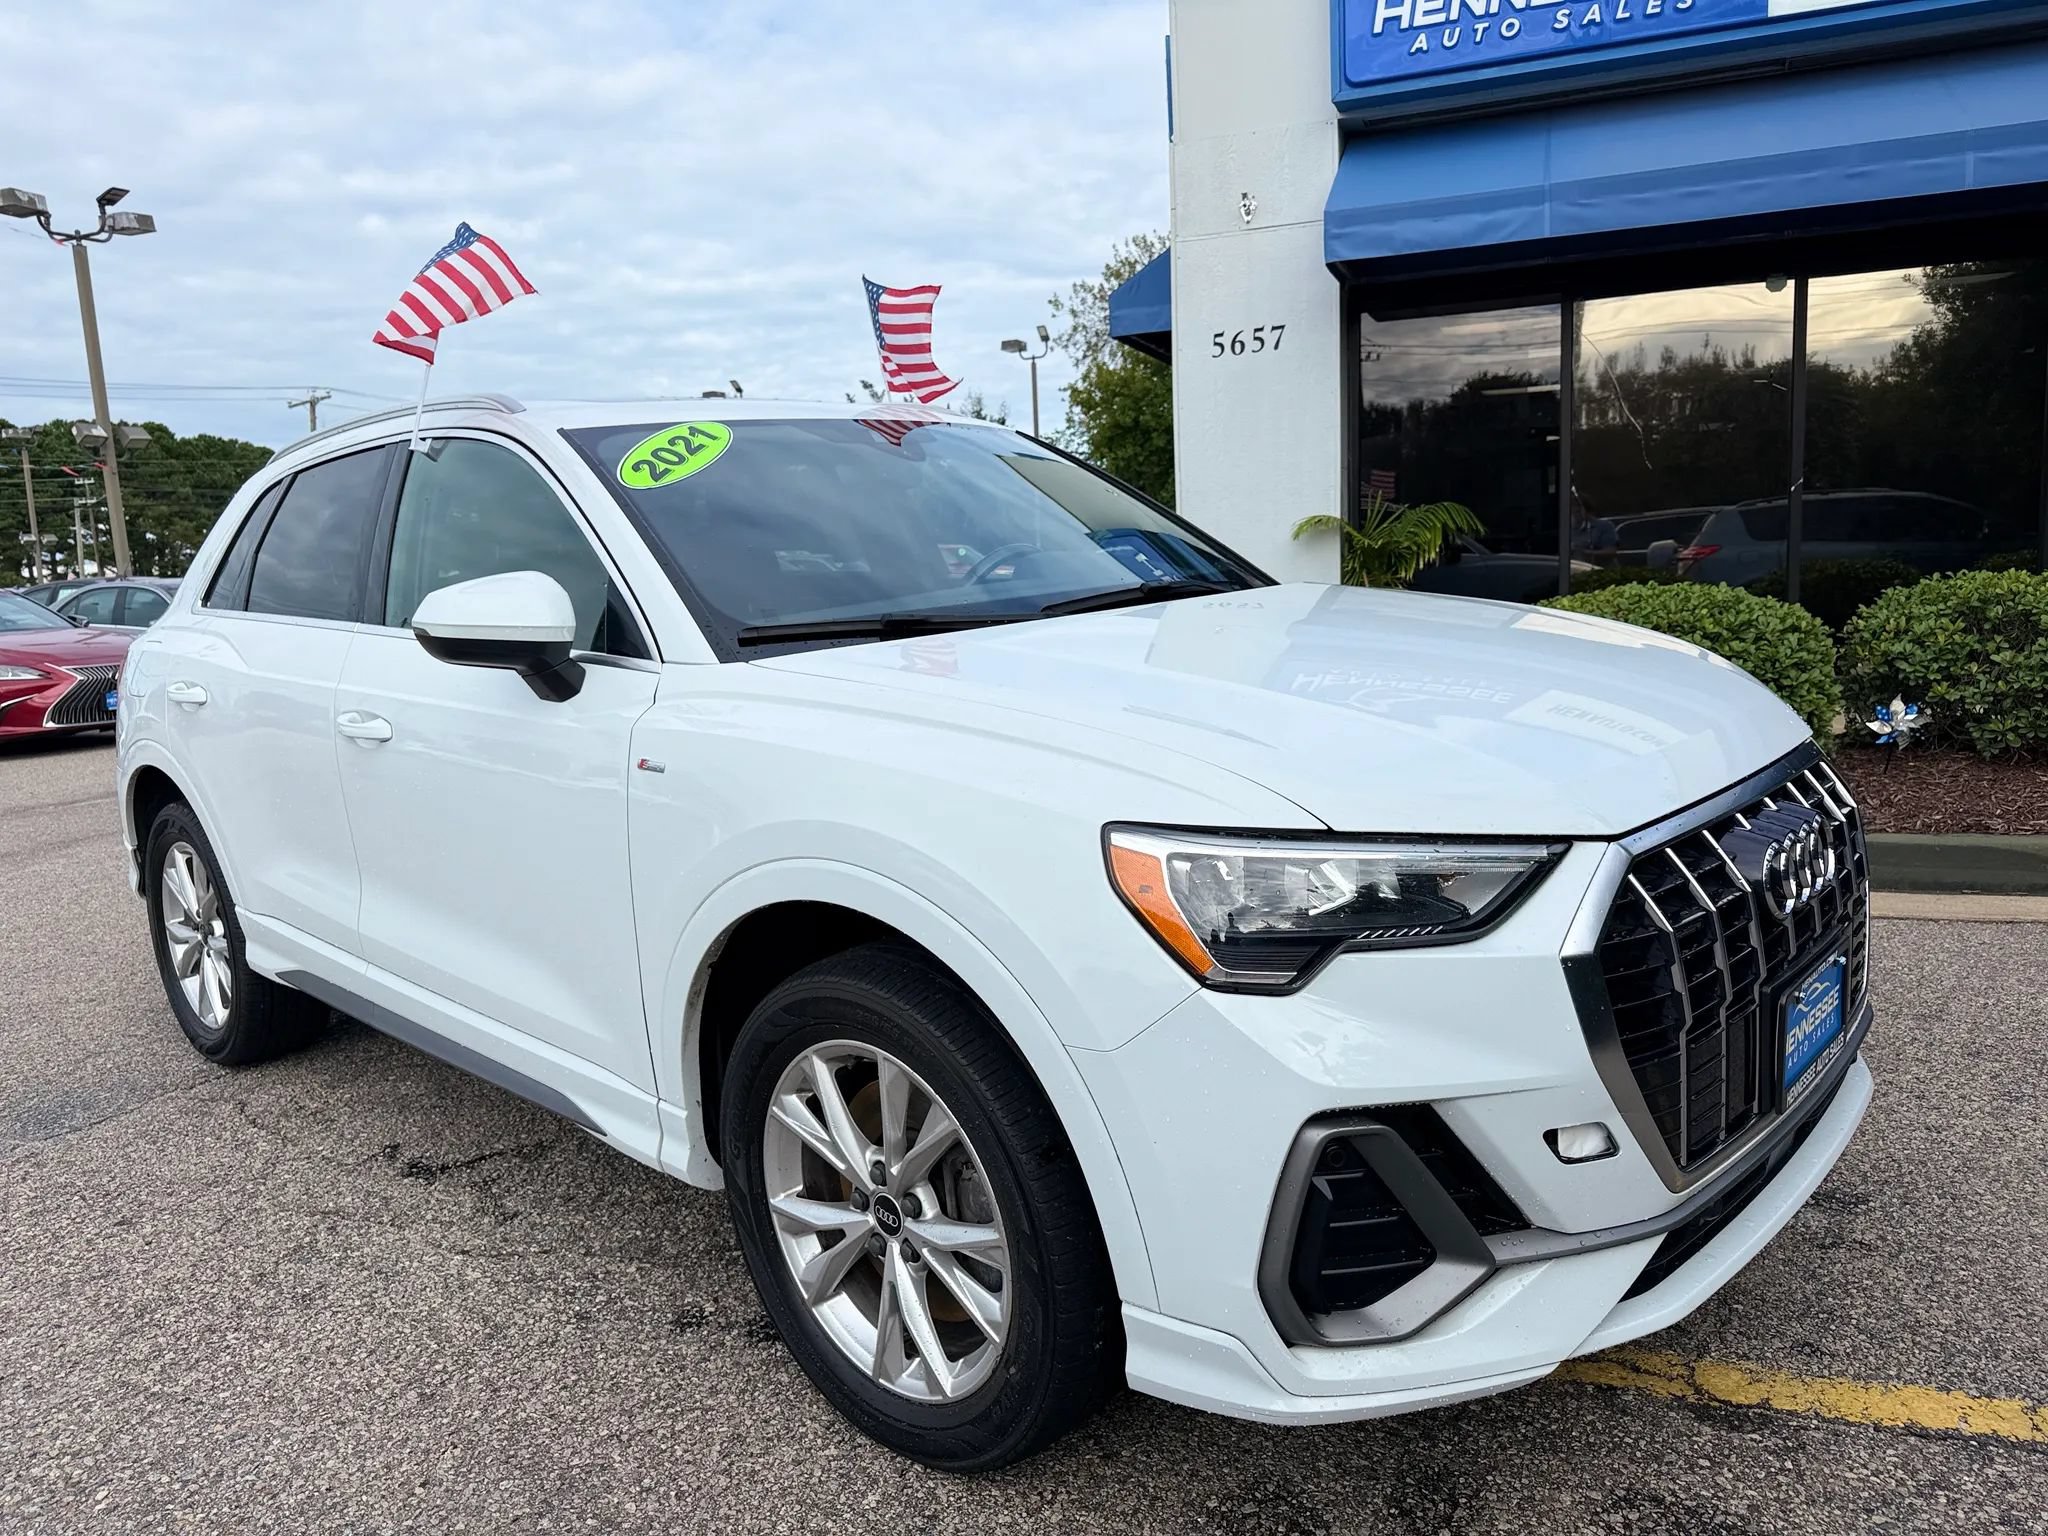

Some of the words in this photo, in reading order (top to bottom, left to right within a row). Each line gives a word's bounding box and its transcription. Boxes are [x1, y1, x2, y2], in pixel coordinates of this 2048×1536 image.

[1410, 17, 1521, 53] AUTO
[1211, 324, 1286, 358] 5657
[632, 425, 721, 483] 2021
[1787, 1041, 1808, 1069] AUTO
[1812, 1013, 1834, 1043] SALES
[1829, 1031, 1844, 1059] SALES
